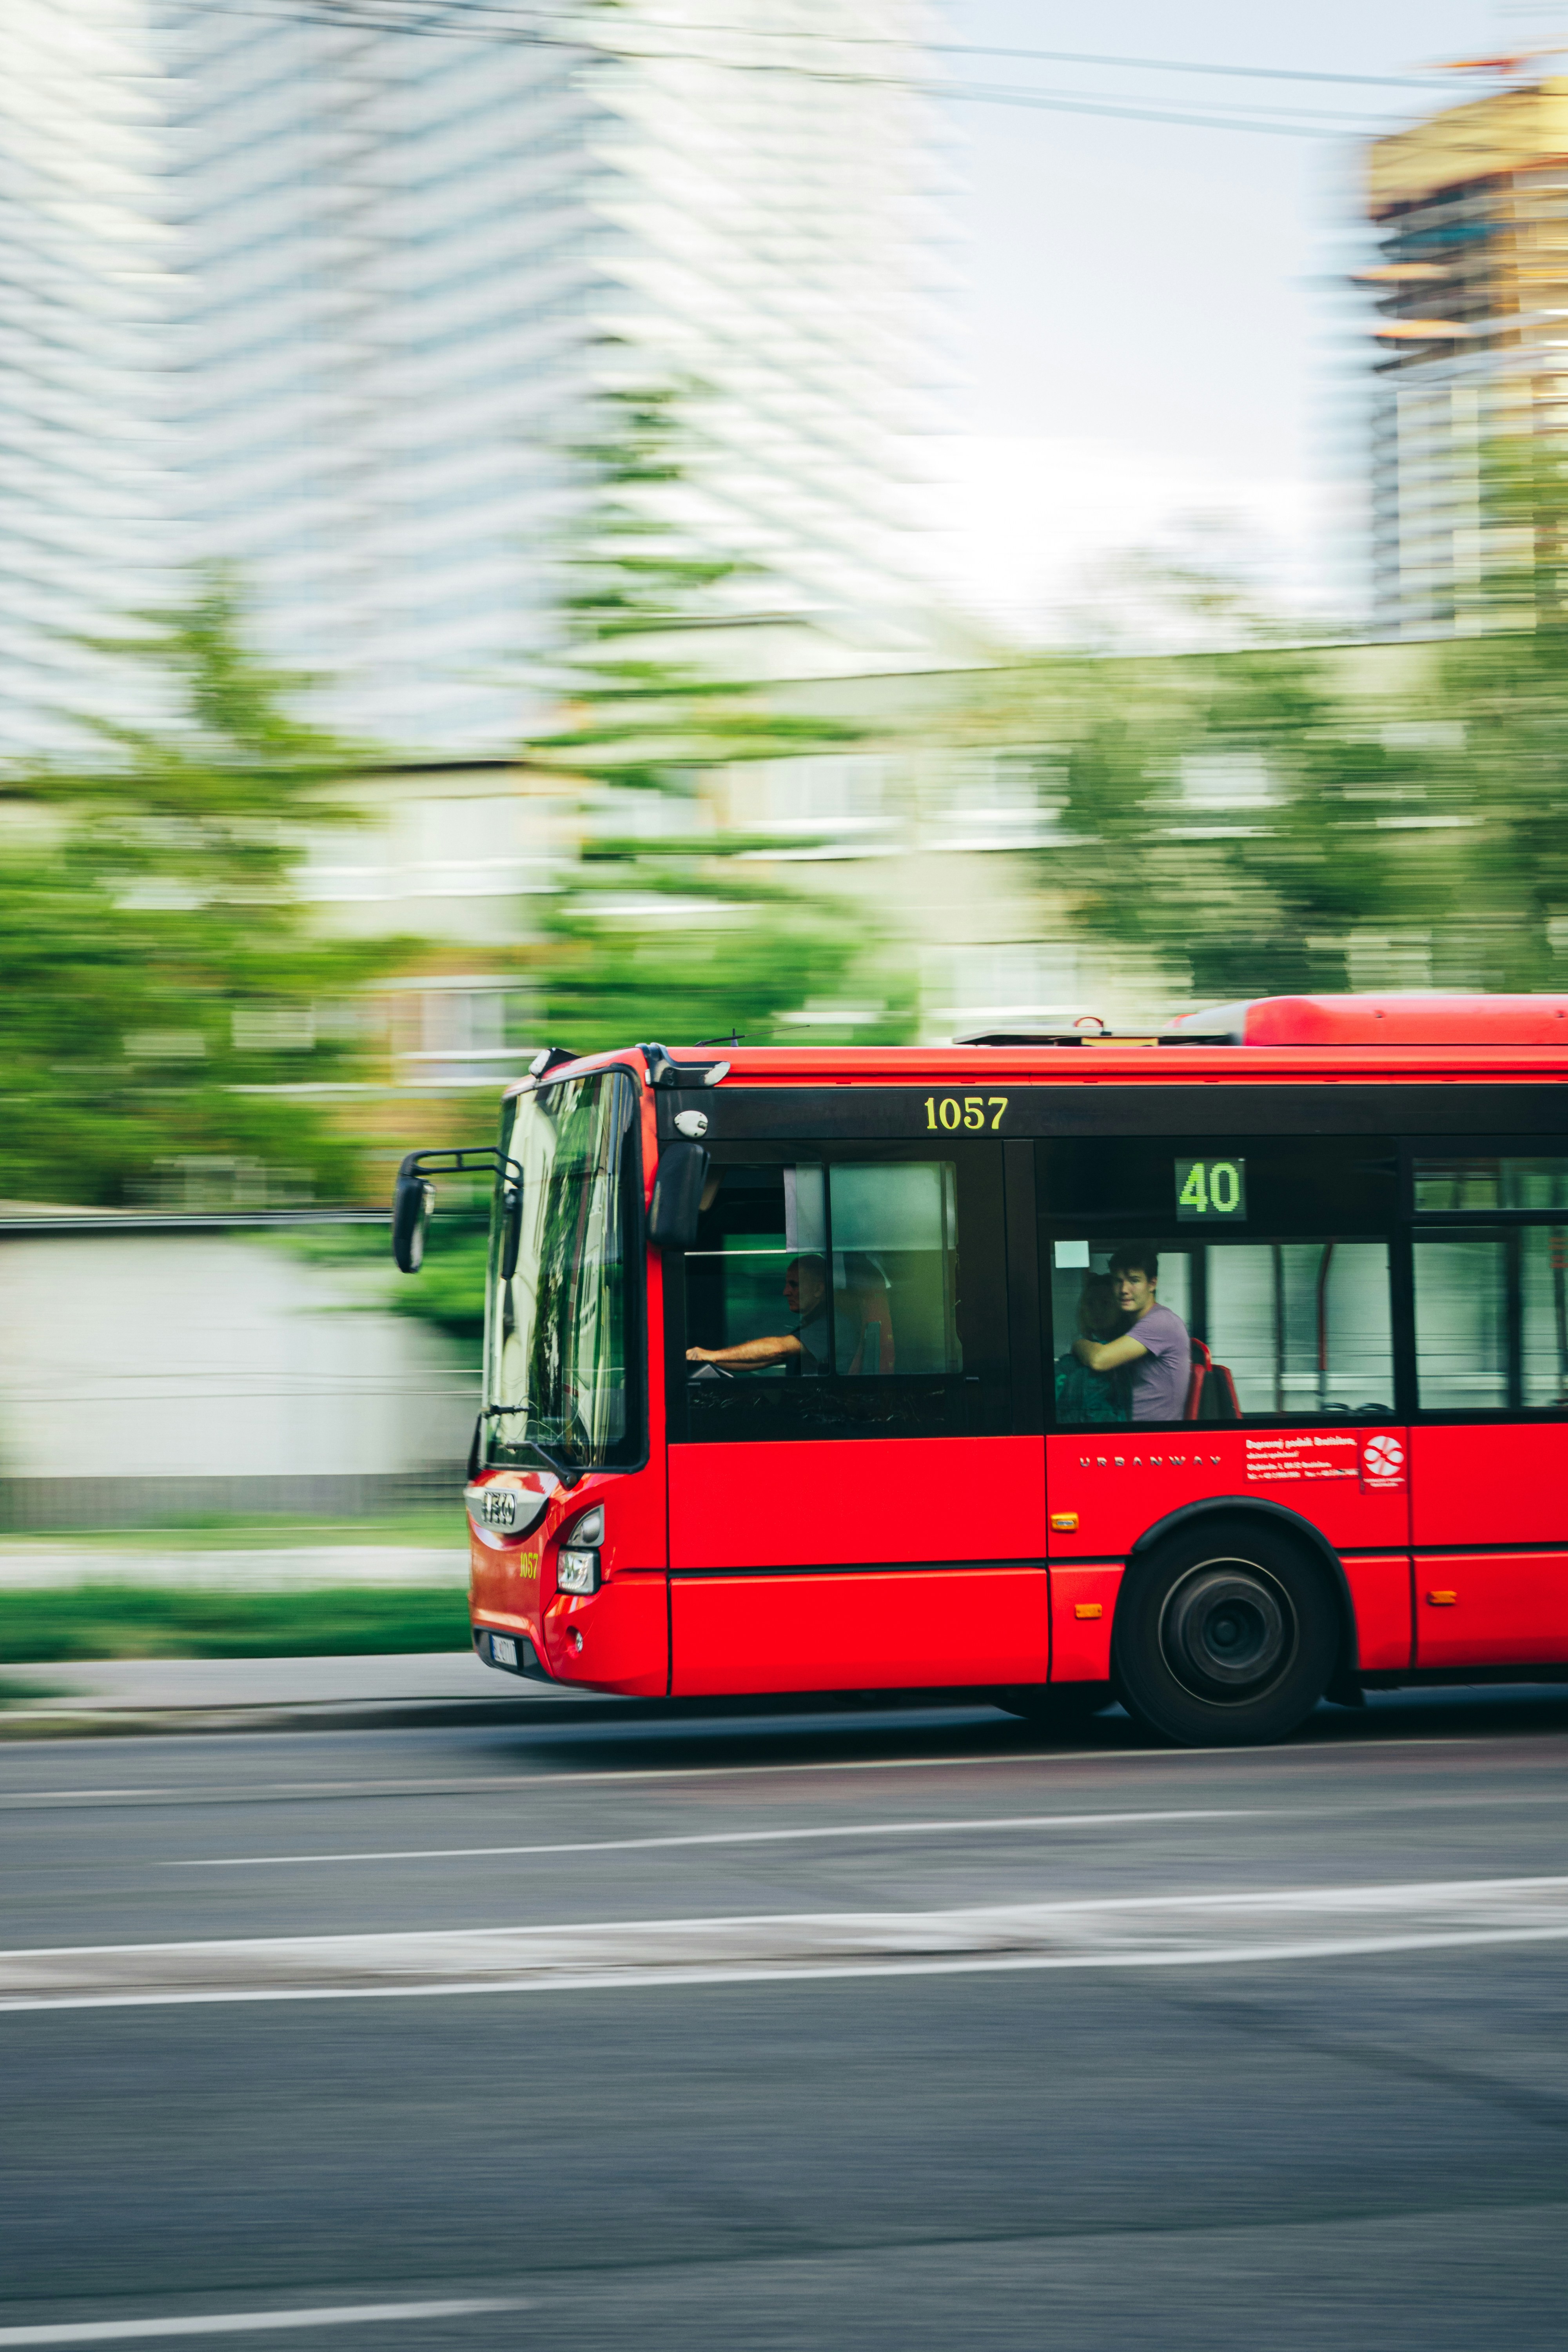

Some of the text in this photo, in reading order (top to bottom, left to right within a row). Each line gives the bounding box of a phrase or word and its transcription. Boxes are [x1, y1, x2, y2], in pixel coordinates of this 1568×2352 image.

[924, 1097, 1008, 1130] 1057
[1179, 1162, 1240, 1212] 40
[1079, 1455, 1221, 1467] URBANWAY
[520, 1552, 539, 1579] 1057
